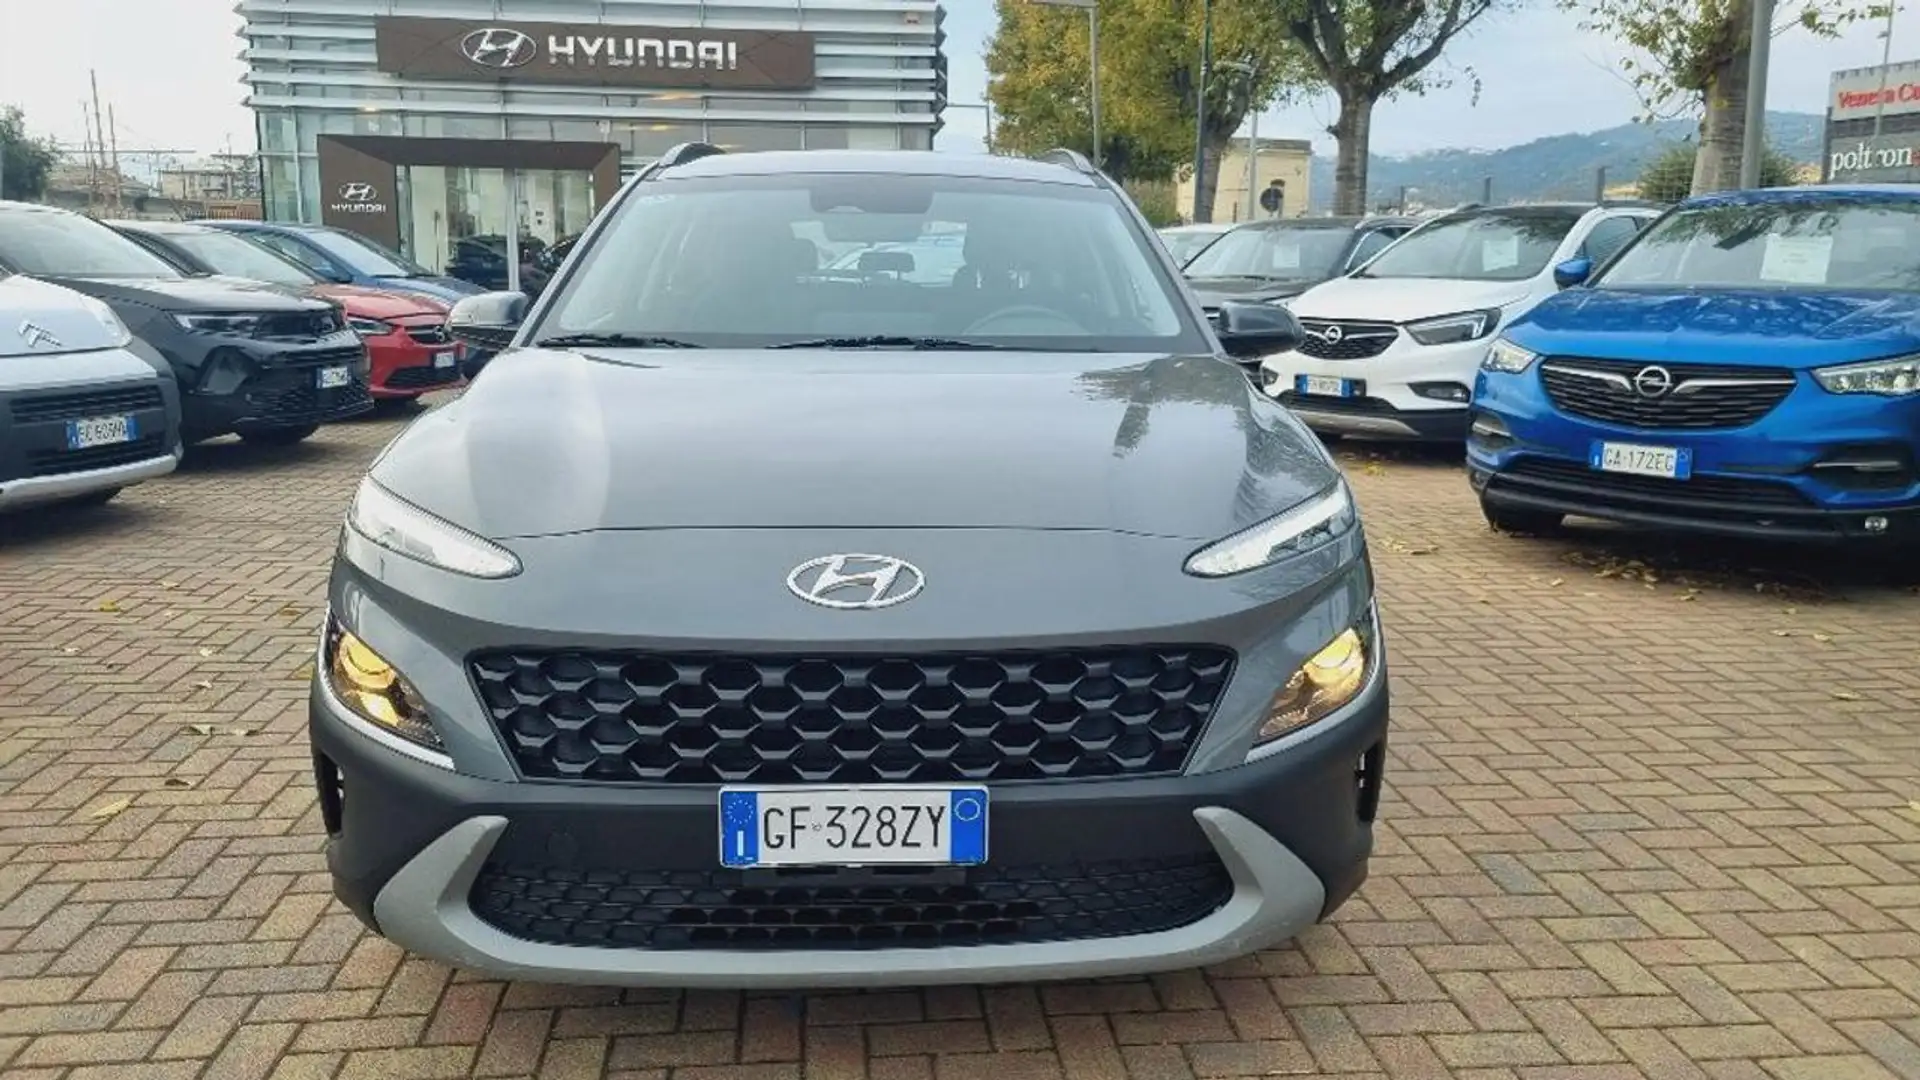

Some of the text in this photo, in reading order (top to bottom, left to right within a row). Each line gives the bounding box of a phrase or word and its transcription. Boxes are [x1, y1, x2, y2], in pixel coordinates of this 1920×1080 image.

[548, 34, 737, 70] HYUNDAI
[1838, 89, 1895, 109] Venea
[331, 203, 387, 213] HYUNDAI
[763, 805, 946, 850] GF 328ZY
